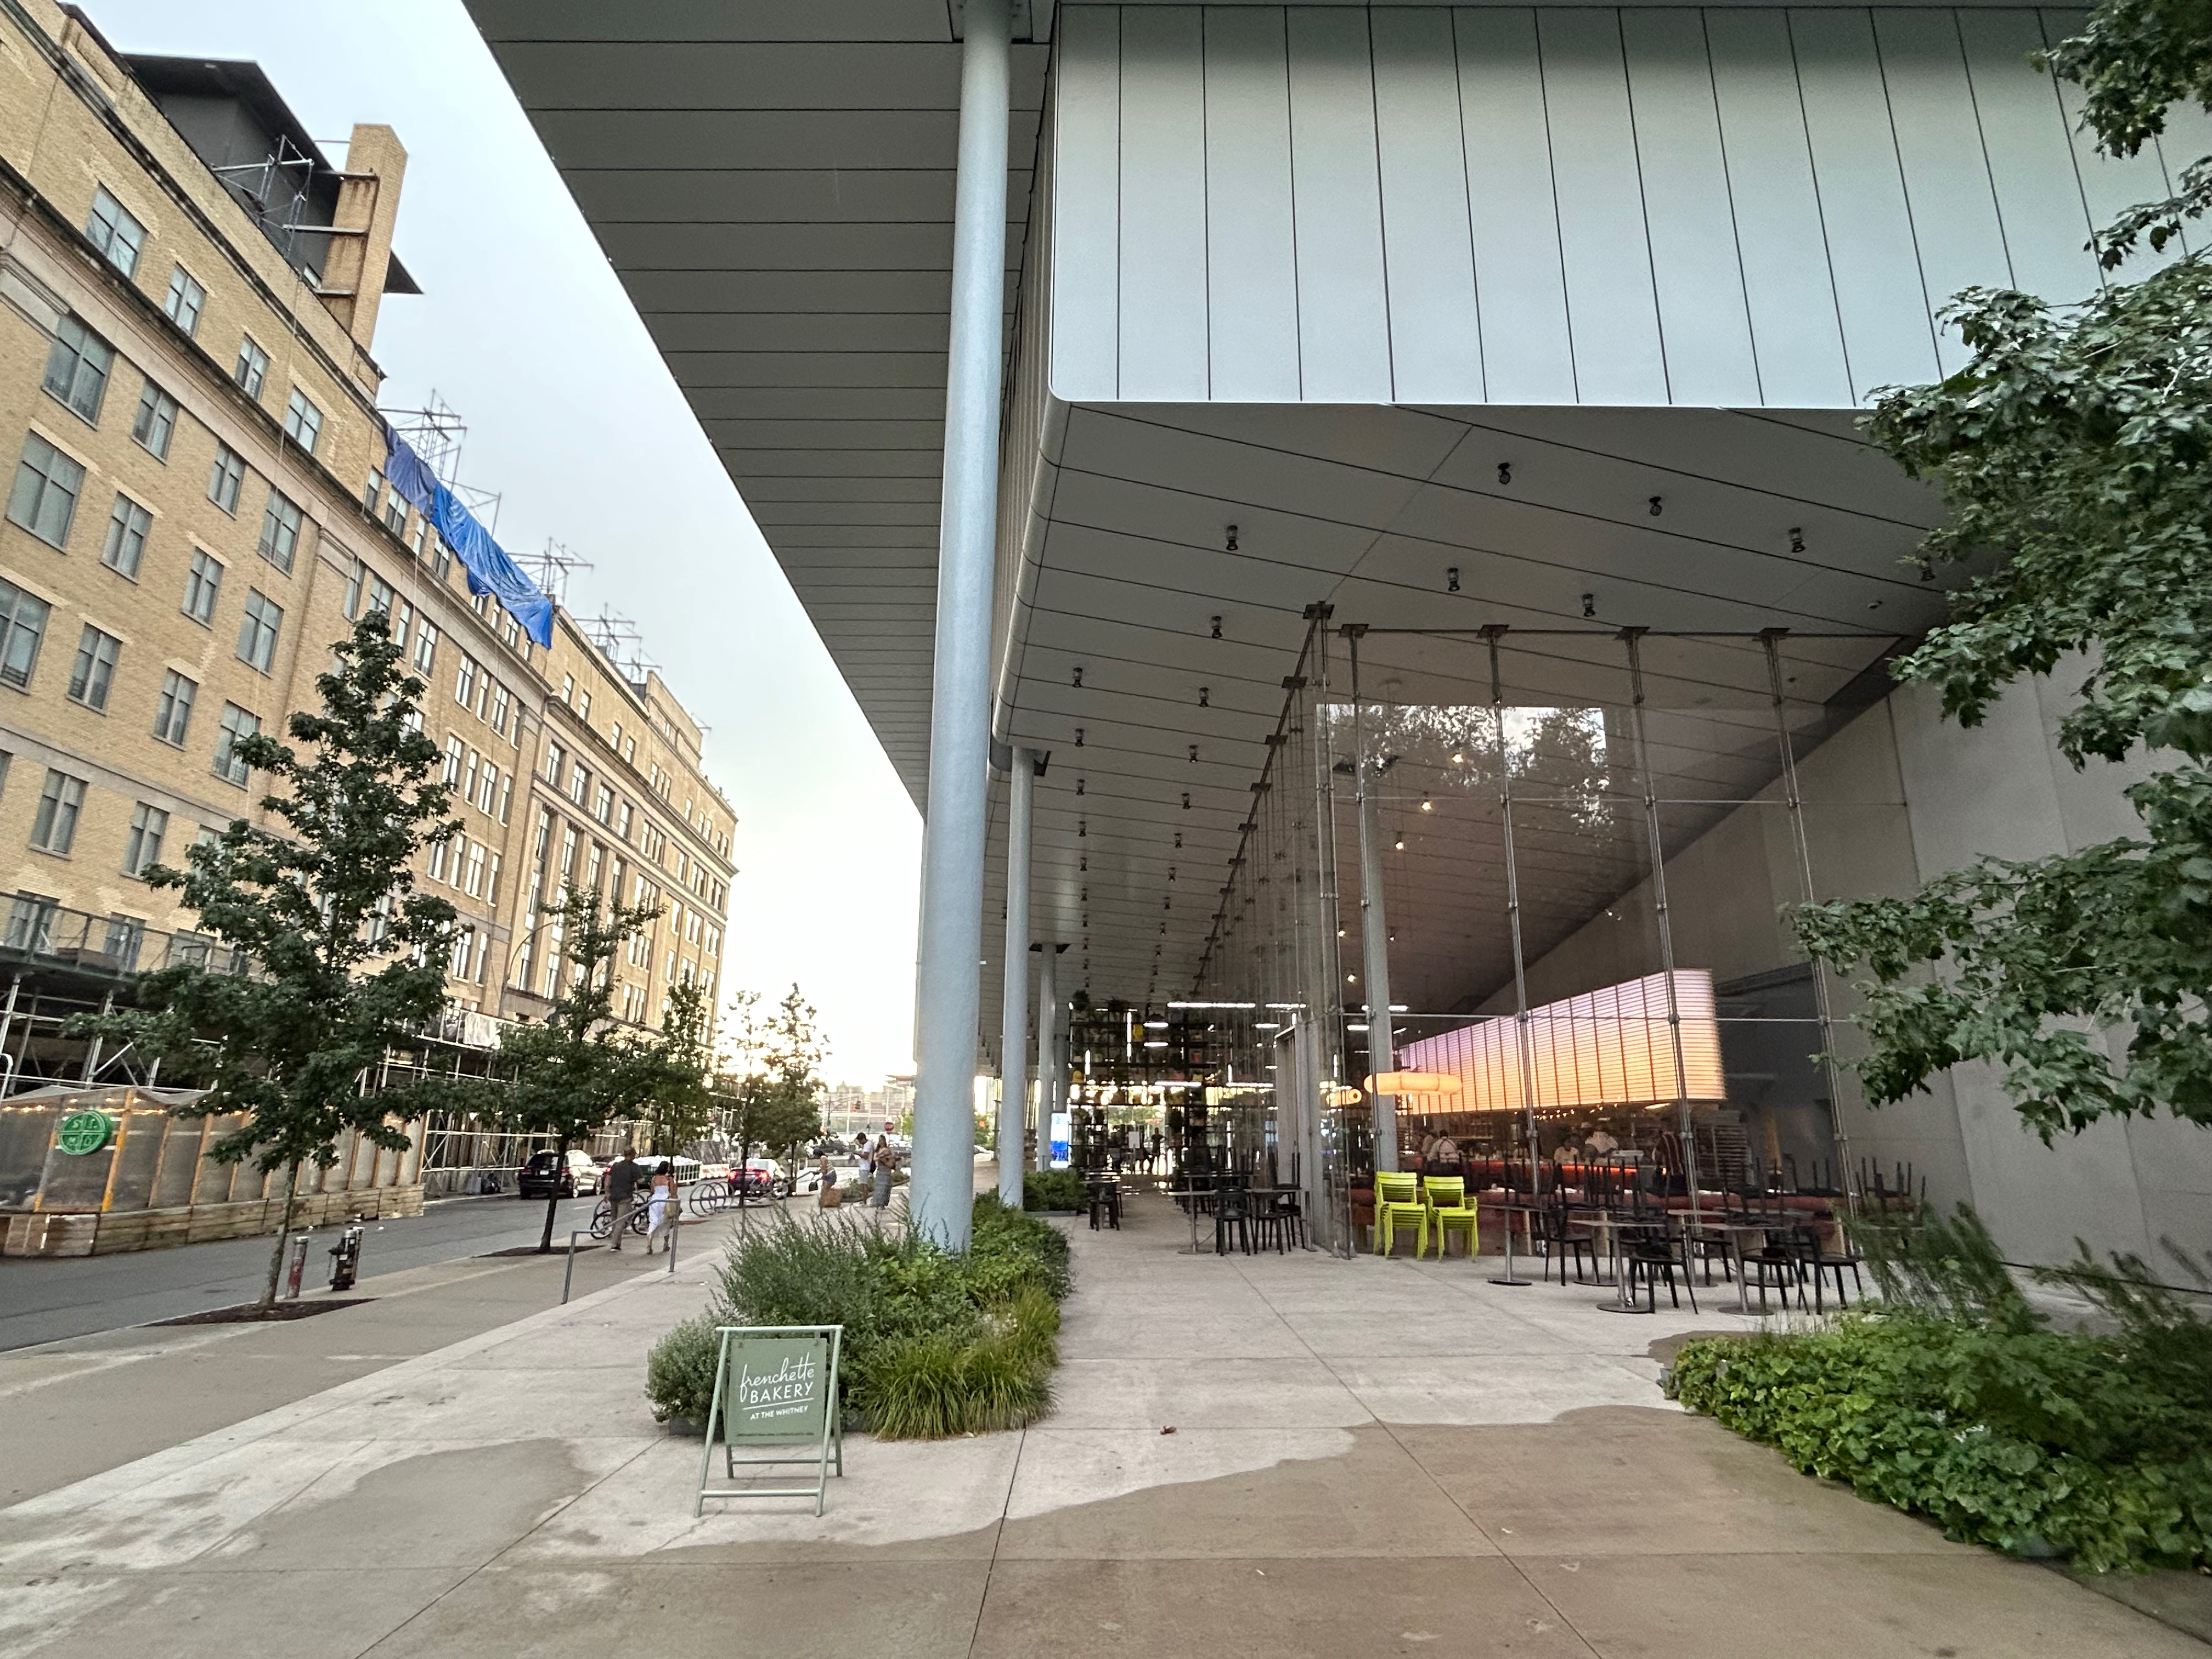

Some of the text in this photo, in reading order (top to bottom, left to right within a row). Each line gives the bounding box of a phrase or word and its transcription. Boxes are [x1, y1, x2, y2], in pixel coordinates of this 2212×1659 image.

[740, 1352, 816, 1403] frenchette
[750, 1381, 814, 1403] BAKERY
[750, 1412, 760, 1420] AT
[776, 1405, 809, 1415] WHITNEY
